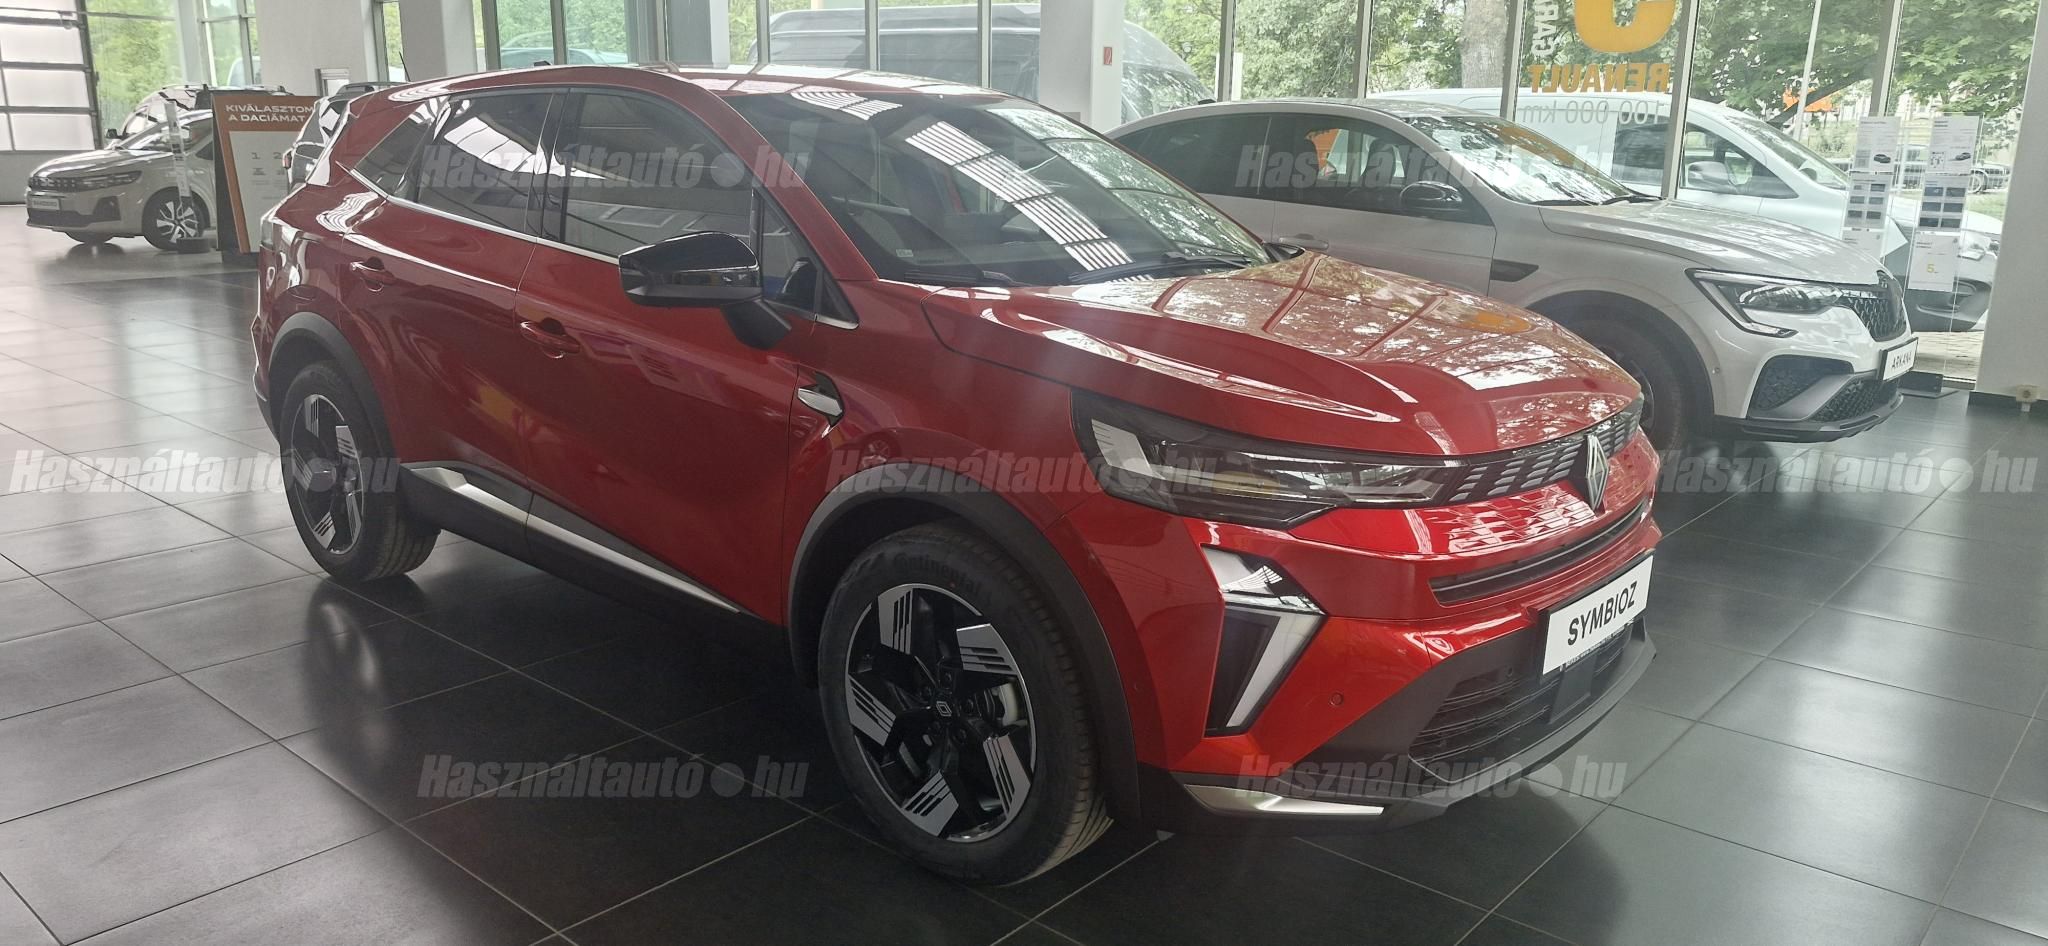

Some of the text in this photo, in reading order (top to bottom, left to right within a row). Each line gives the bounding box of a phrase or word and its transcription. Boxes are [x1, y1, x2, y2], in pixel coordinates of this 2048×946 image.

[225, 104, 313, 113] KIVÁLASZTOM
[240, 113, 305, 122] DACIÁMAT
[1567, 581, 1638, 646] SYMBIOZ
